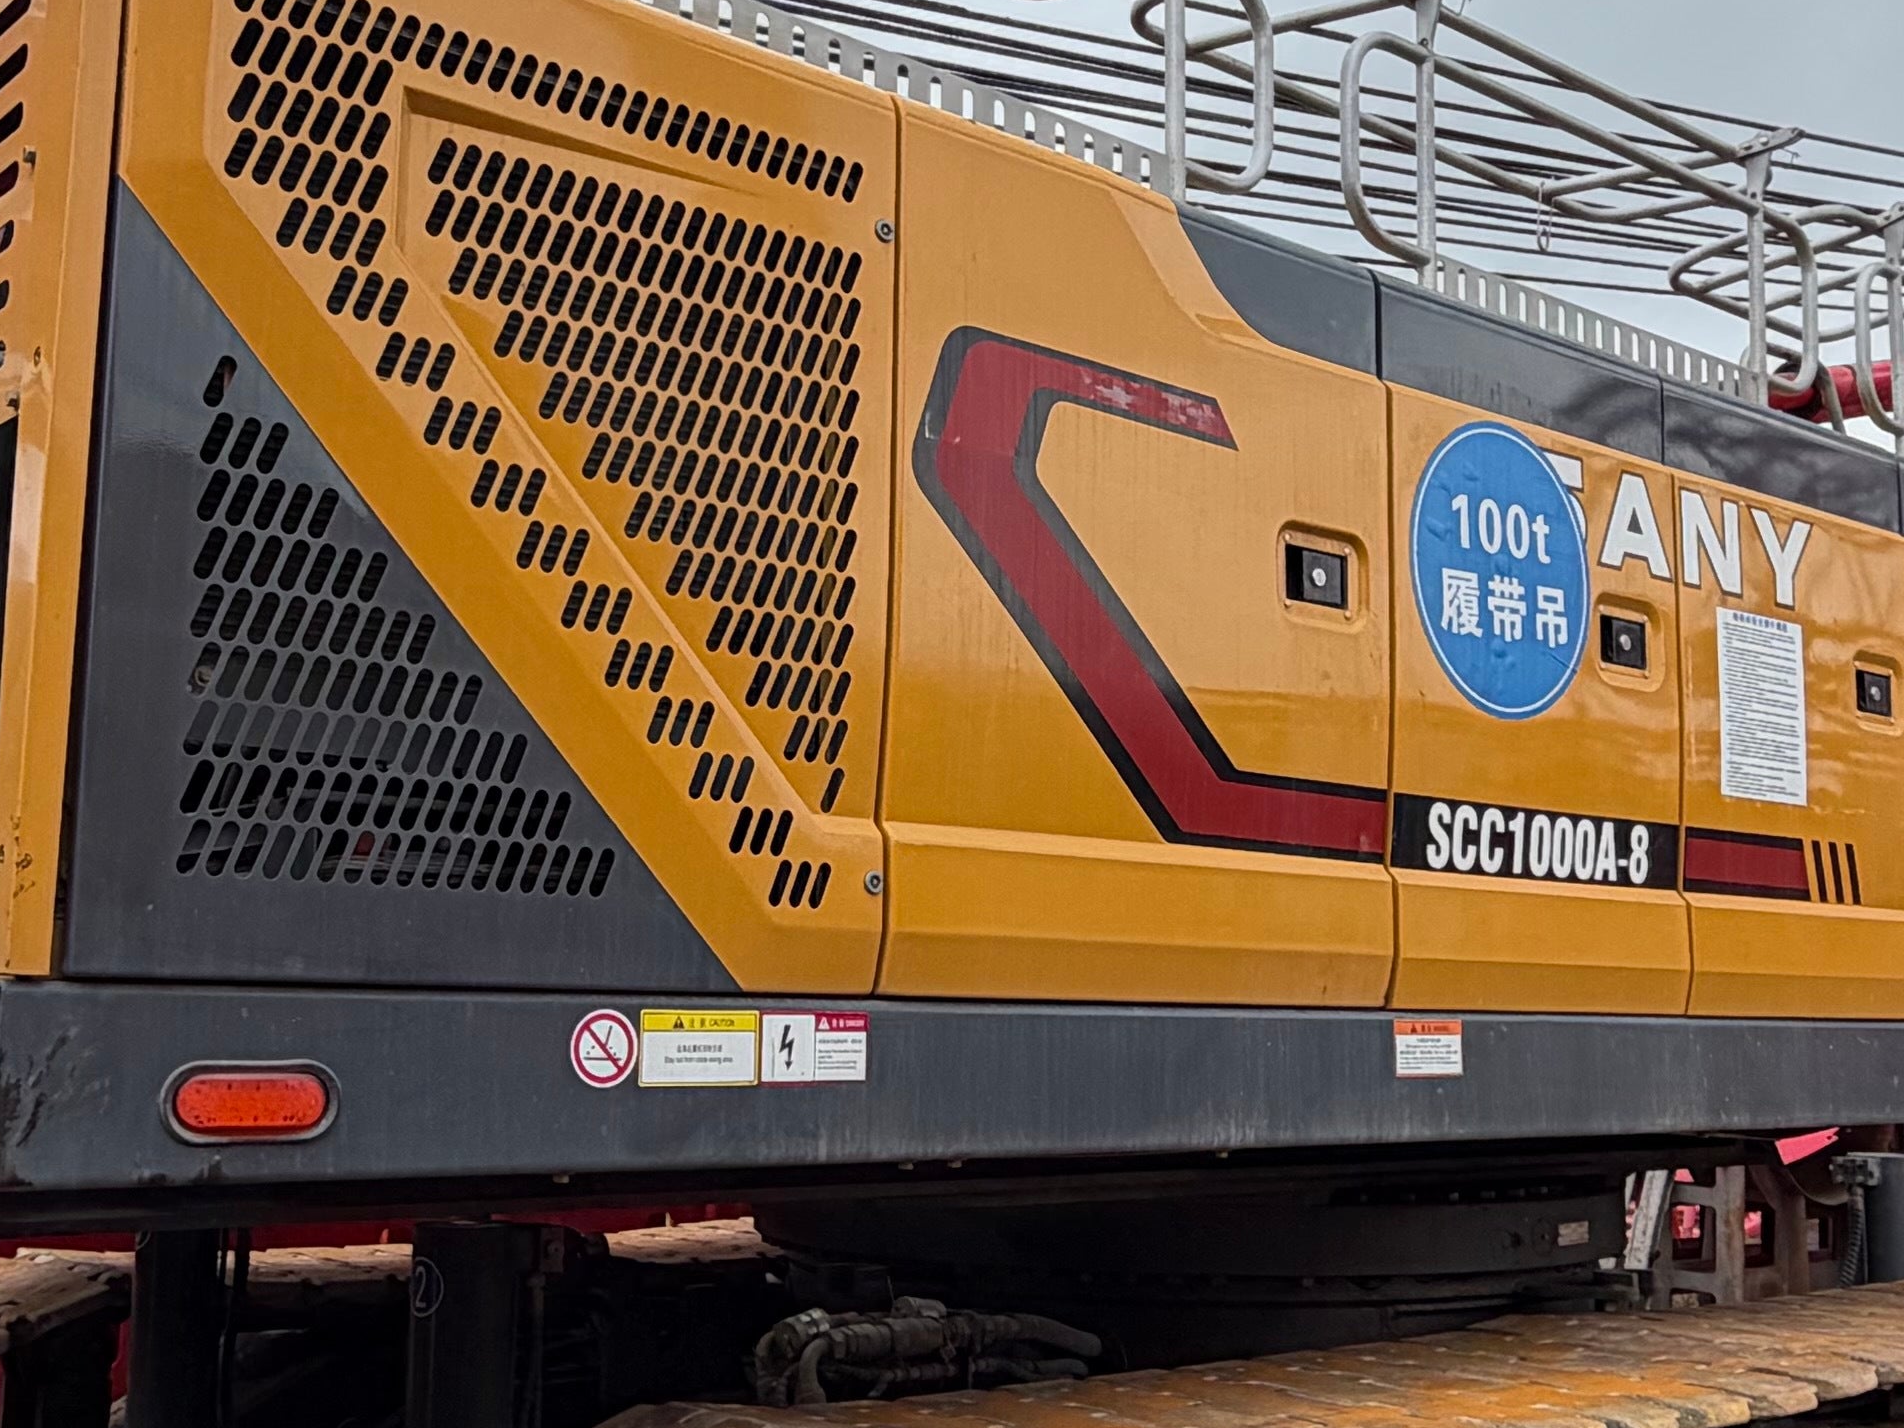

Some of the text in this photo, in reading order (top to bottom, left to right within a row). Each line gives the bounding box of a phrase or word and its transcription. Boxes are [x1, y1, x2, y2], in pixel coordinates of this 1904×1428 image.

[1450, 493, 1552, 565] 100t
[1439, 567, 1569, 649] 履带吊
[1425, 801, 1650, 885] SCC1000A-8
